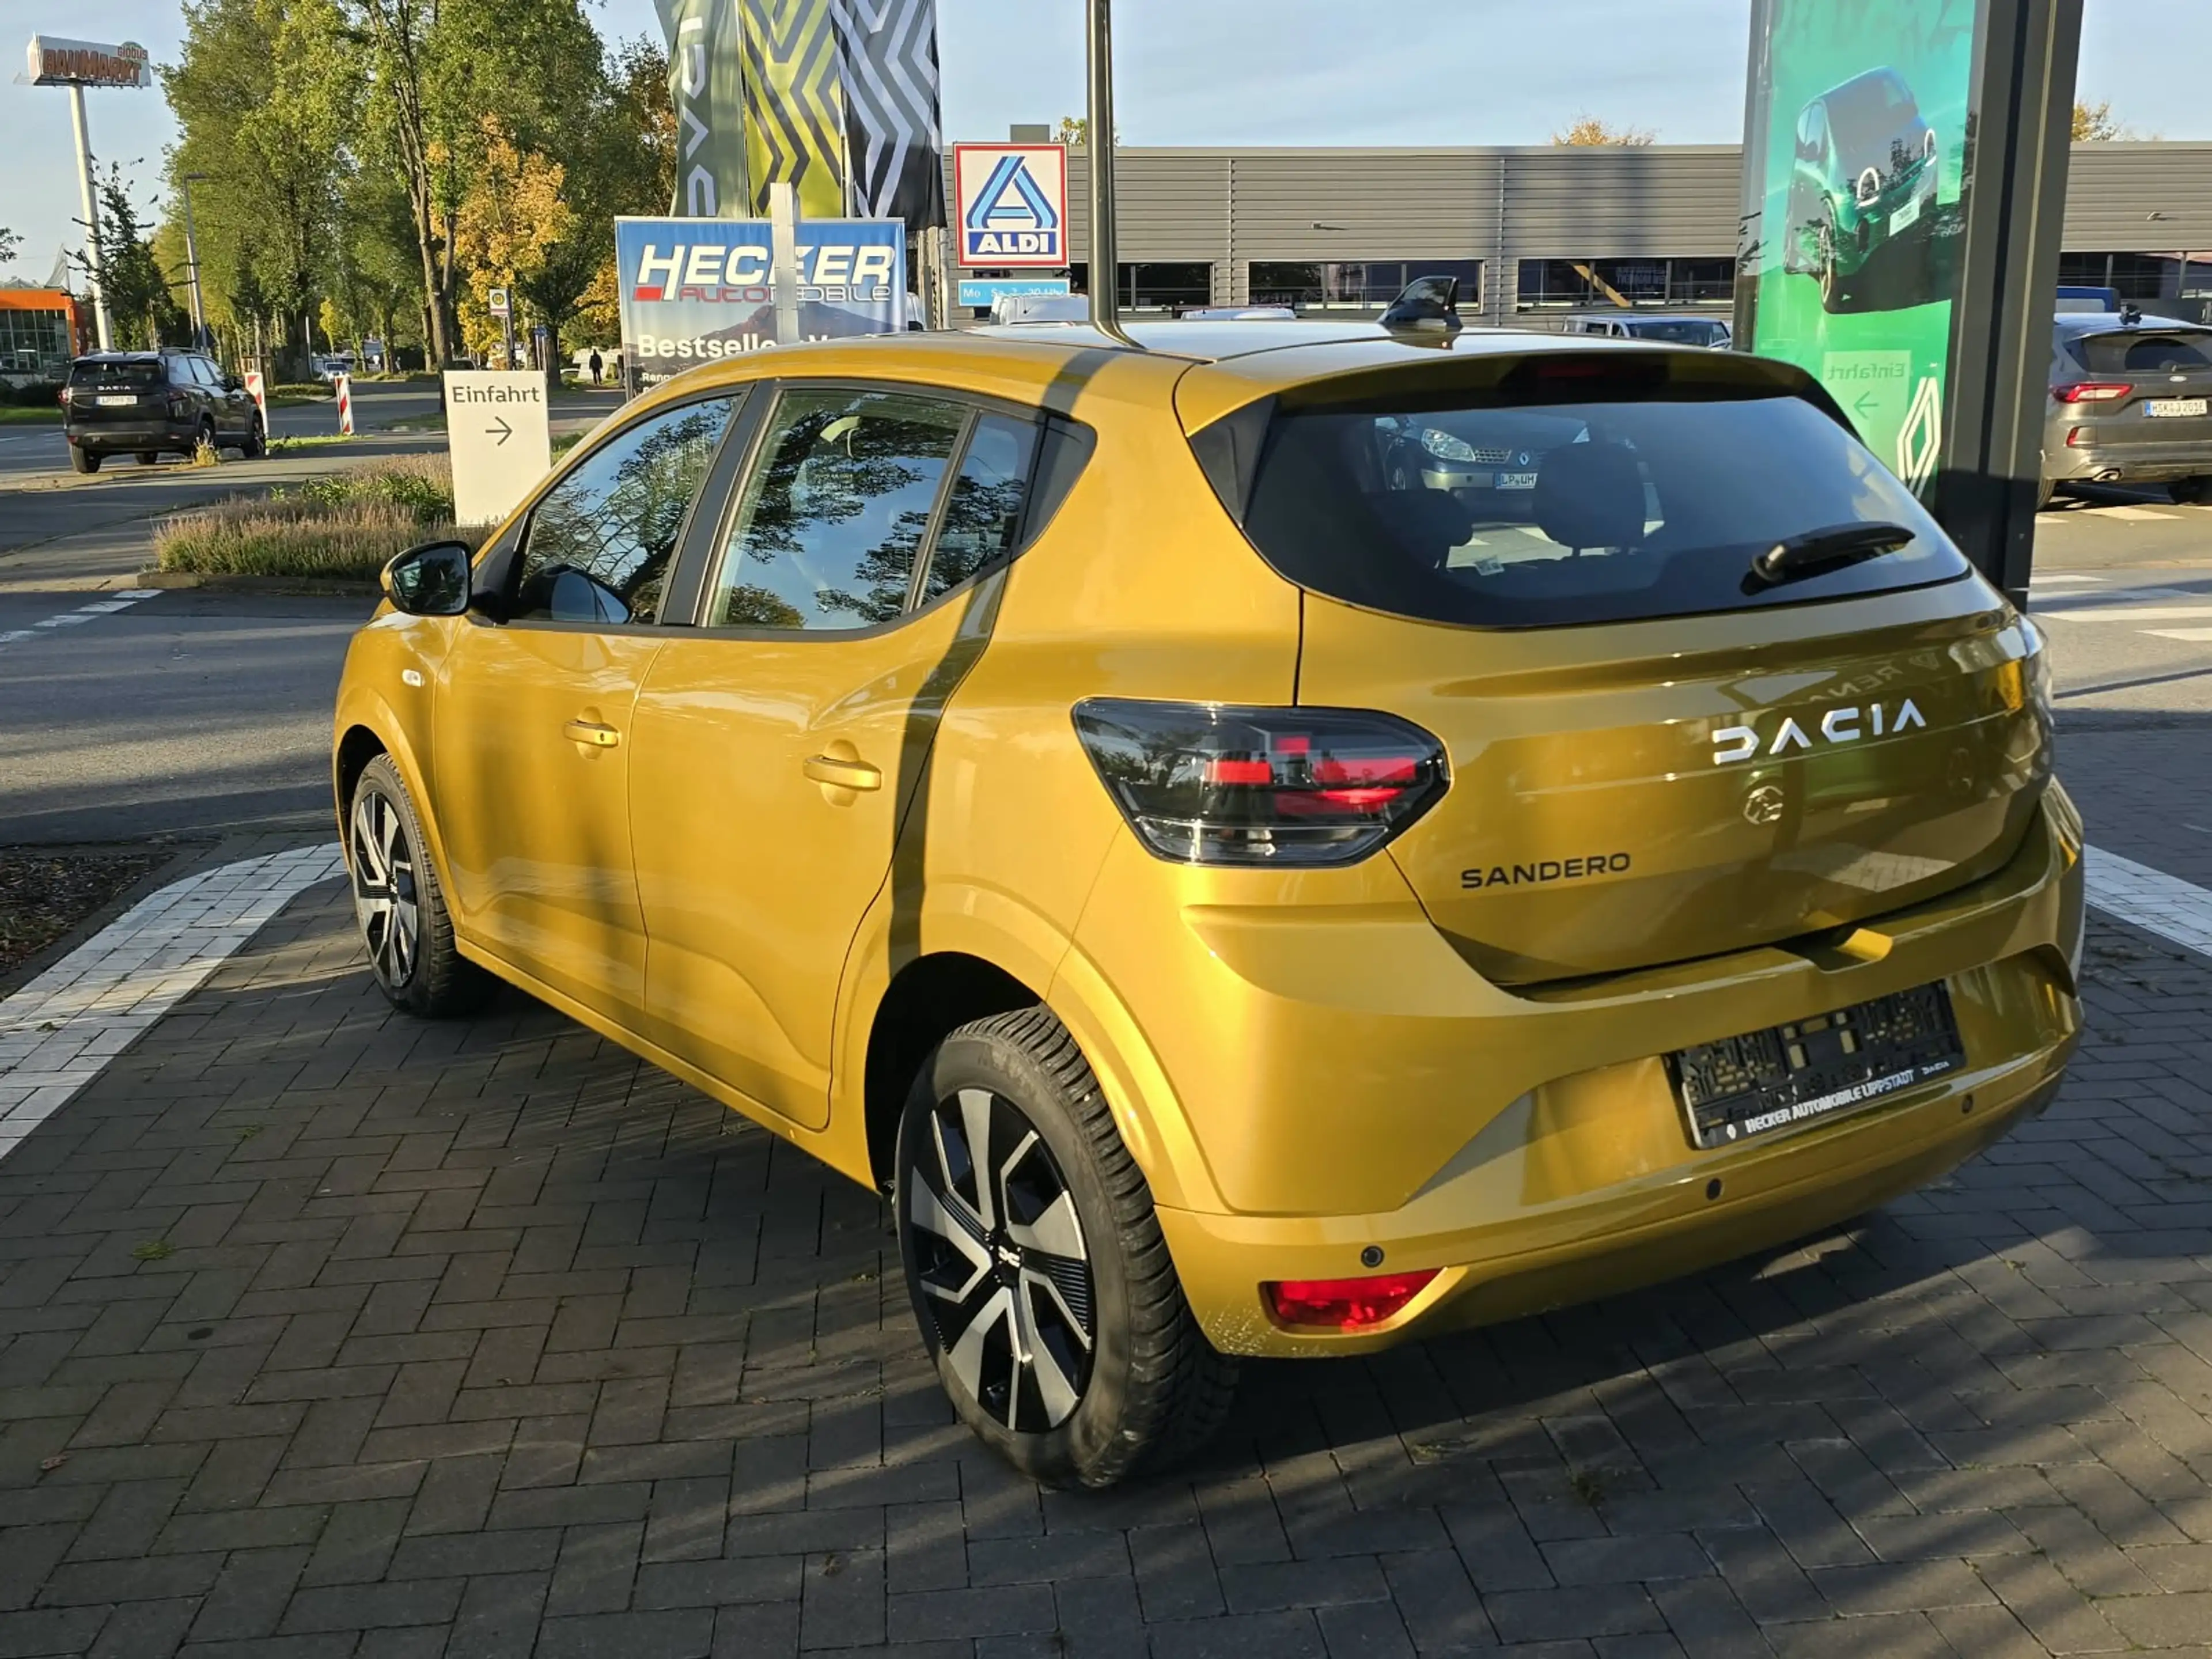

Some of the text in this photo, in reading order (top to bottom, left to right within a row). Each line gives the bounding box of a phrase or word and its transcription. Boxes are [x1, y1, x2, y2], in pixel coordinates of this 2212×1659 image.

[43, 49, 142, 85] BAUMARKT
[977, 233, 1049, 253] ALDI
[638, 334, 777, 358] Bestselle
[452, 385, 540, 403] Einfahrt
[1713, 698, 1926, 765] DACIA
[1461, 853, 1631, 889] SANDERO
[1745, 1108, 1791, 1134] HECKER
[1791, 1085, 1863, 1120] AUTOMOBILE
[1861, 1069, 1915, 1097] LIPPSTADT
